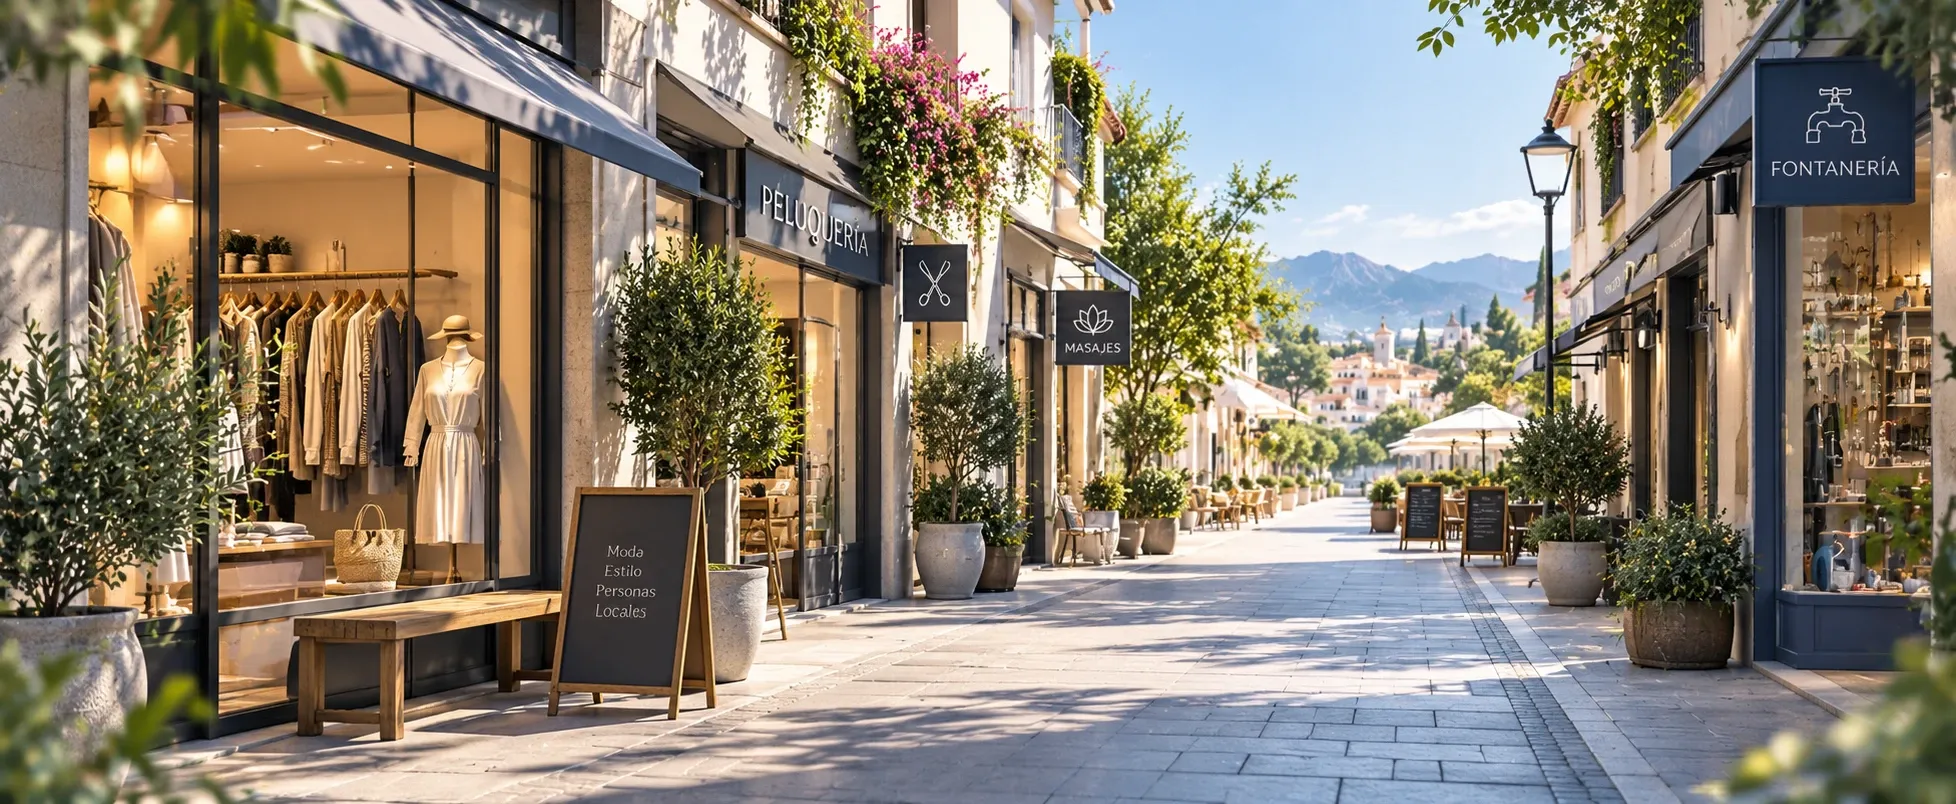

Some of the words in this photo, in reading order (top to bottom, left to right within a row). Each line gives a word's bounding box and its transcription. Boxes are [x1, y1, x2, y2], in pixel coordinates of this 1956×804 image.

[1771, 155, 1900, 177] FONTANERÍA
[1064, 342, 1121, 354] MASAJES
[606, 544, 644, 558] Moda
[604, 564, 642, 577] Estilo
[595, 584, 656, 598] Personas
[595, 603, 647, 619] Locales
